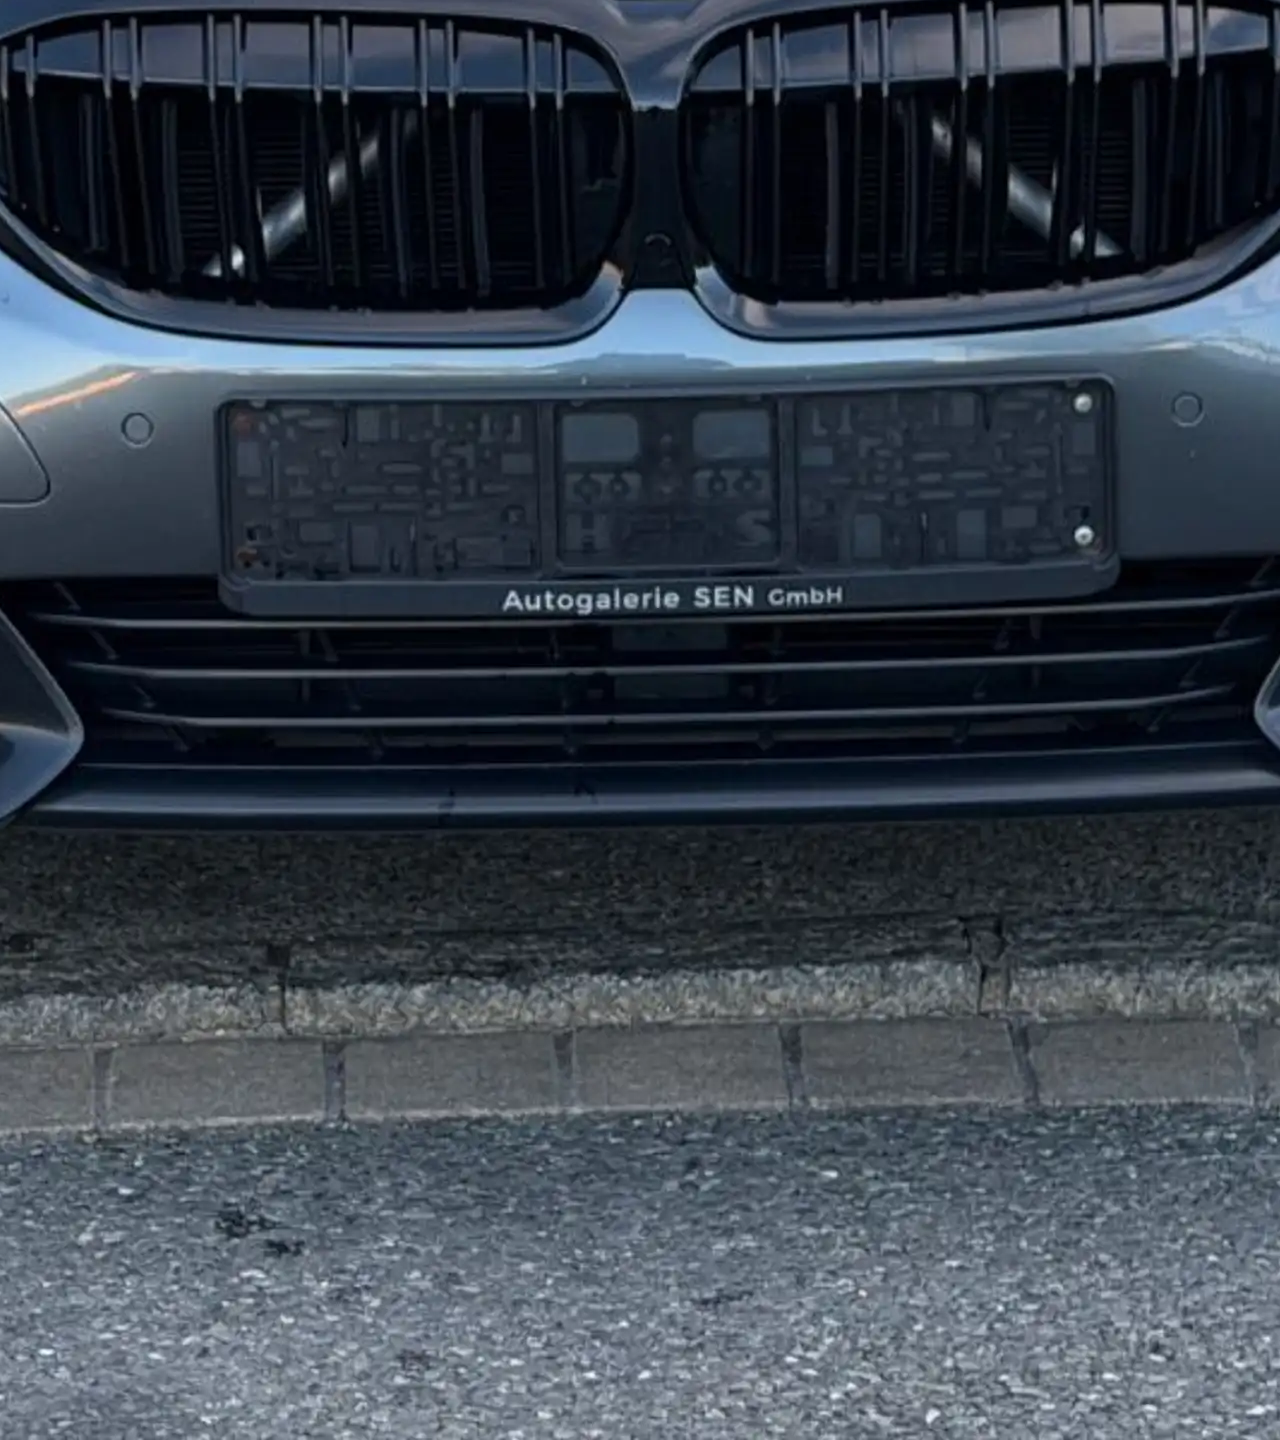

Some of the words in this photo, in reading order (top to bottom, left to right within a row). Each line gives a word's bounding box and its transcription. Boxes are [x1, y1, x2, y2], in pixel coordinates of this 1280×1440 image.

[503, 587, 681, 615] Autogalerie
[693, 586, 754, 608] SEN
[769, 587, 843, 606] GmbH
